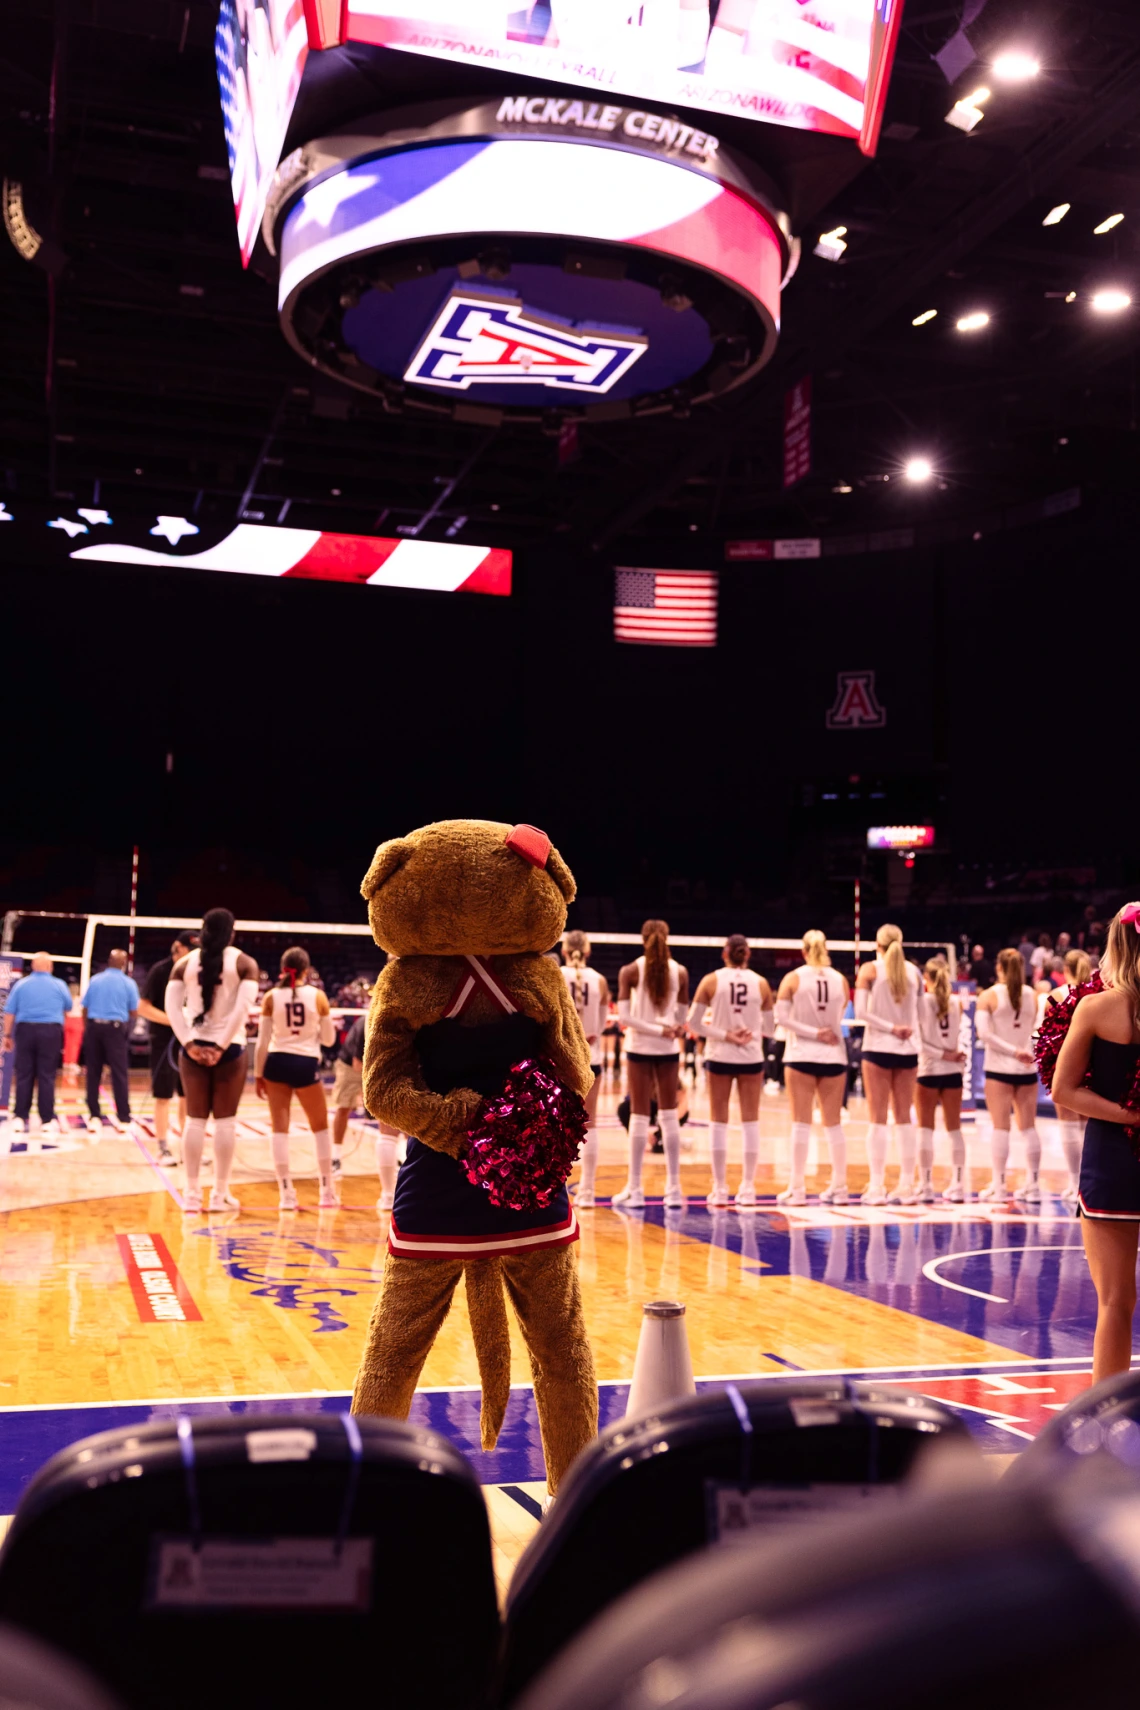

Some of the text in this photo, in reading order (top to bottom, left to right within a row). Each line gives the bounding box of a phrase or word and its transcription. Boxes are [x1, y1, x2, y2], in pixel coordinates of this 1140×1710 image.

[496, 96, 719, 159] MCKALE CENTER
[403, 291, 648, 394] A
[826, 670, 886, 729] A
[729, 982, 748, 1006] 12
[817, 980, 829, 1003] 11
[285, 1002, 305, 1027] 19
